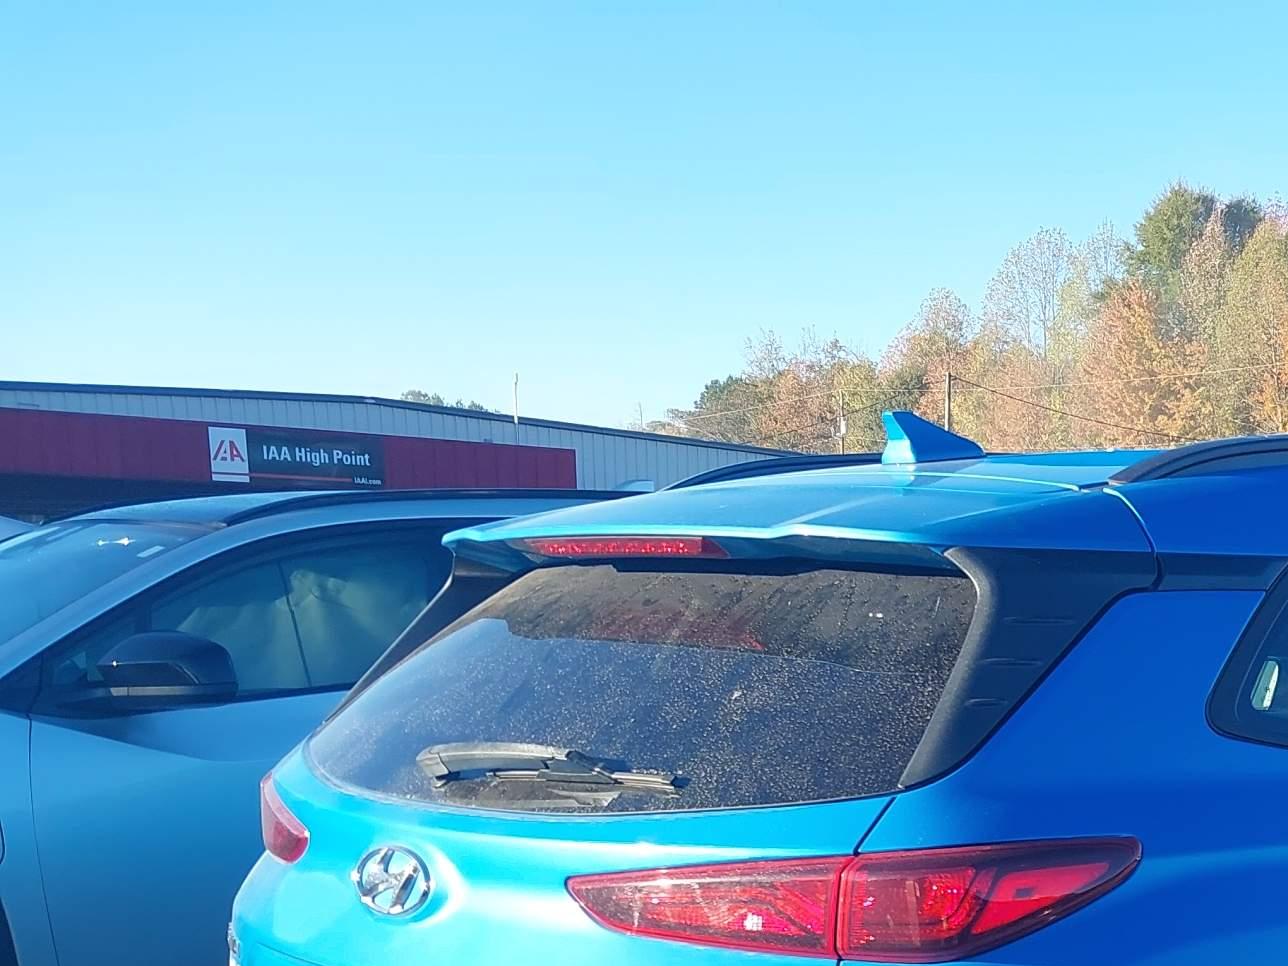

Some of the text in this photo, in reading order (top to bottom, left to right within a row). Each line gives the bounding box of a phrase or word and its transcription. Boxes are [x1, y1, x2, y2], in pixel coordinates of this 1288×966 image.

[262, 445, 371, 466] IAA High Point
